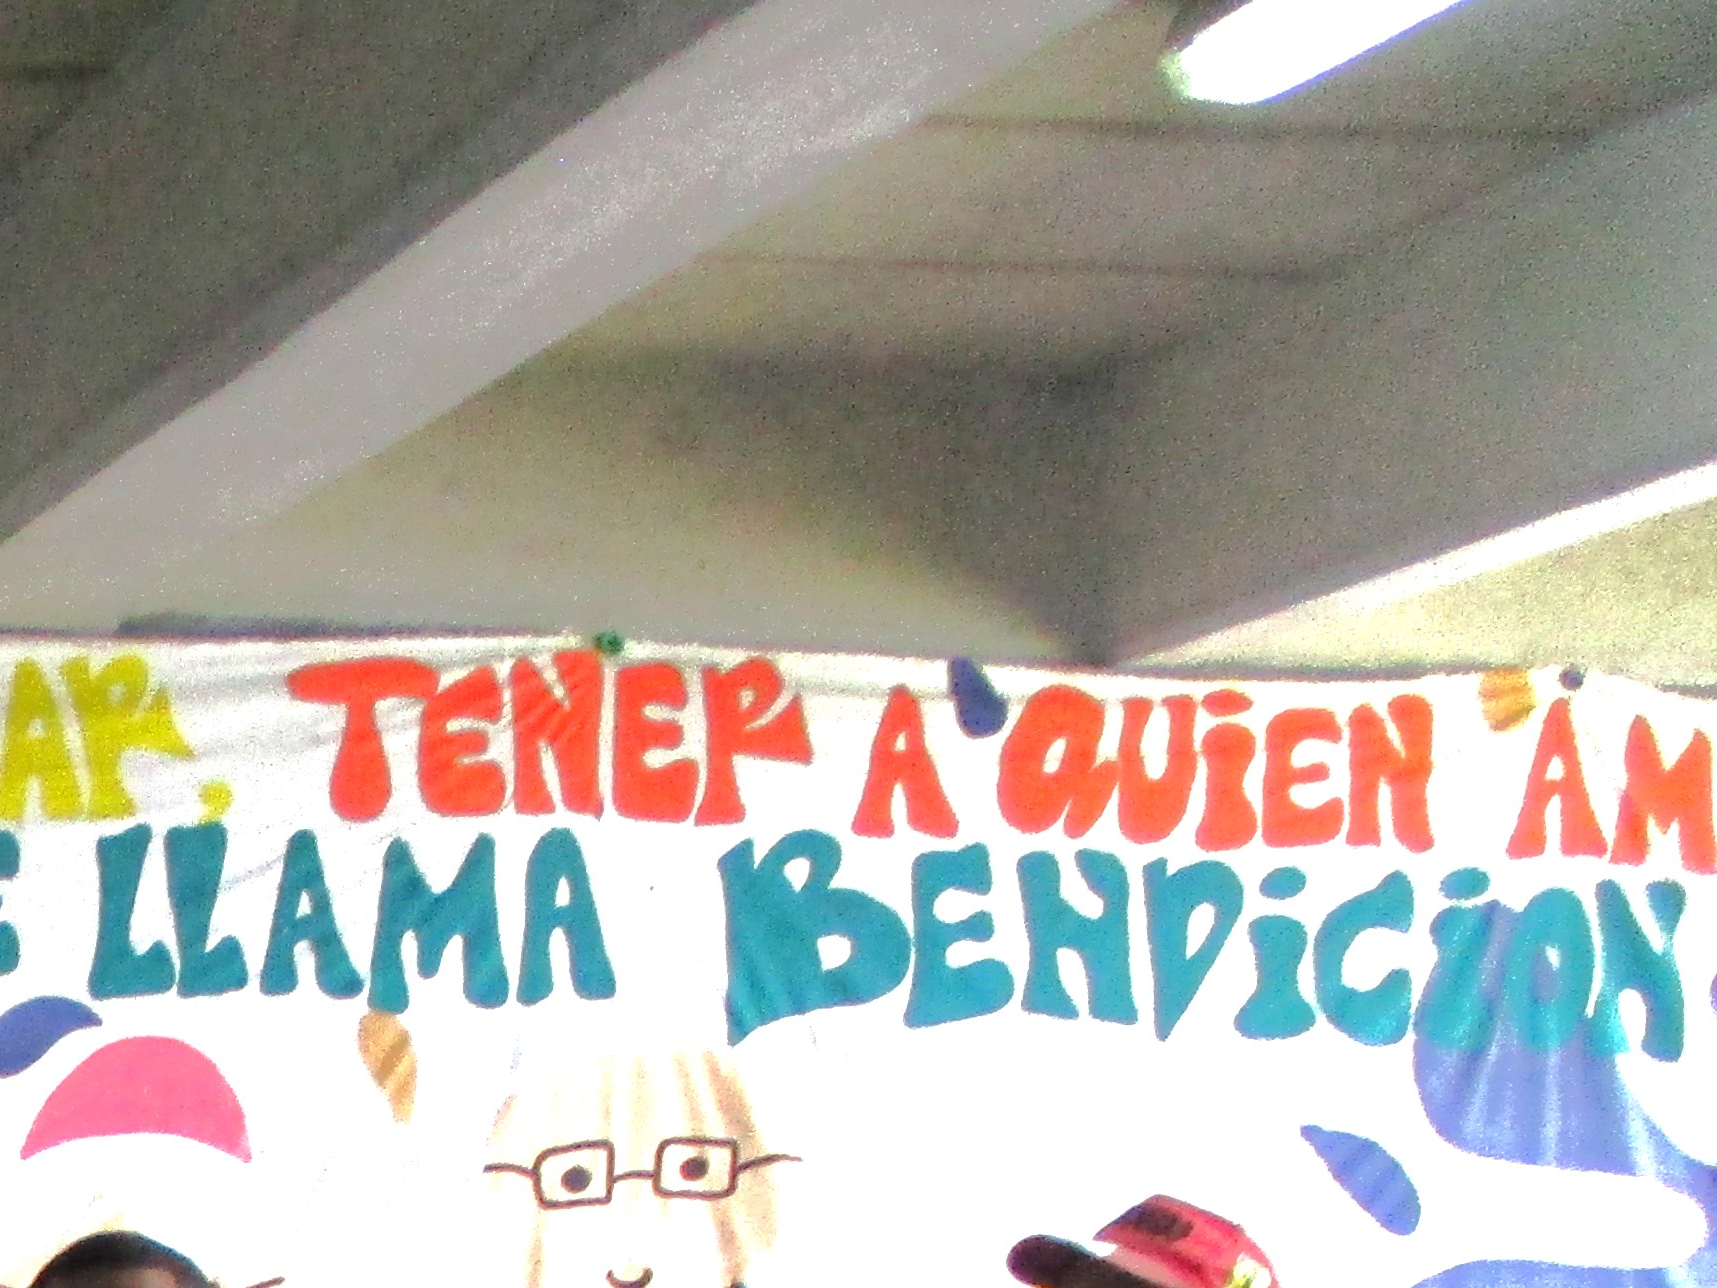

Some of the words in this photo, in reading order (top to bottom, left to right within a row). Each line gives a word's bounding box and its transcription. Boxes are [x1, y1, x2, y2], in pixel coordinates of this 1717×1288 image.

[288, 648, 813, 828] TENER
[851, 685, 960, 839] A
[88, 822, 616, 1013] LLAMA
